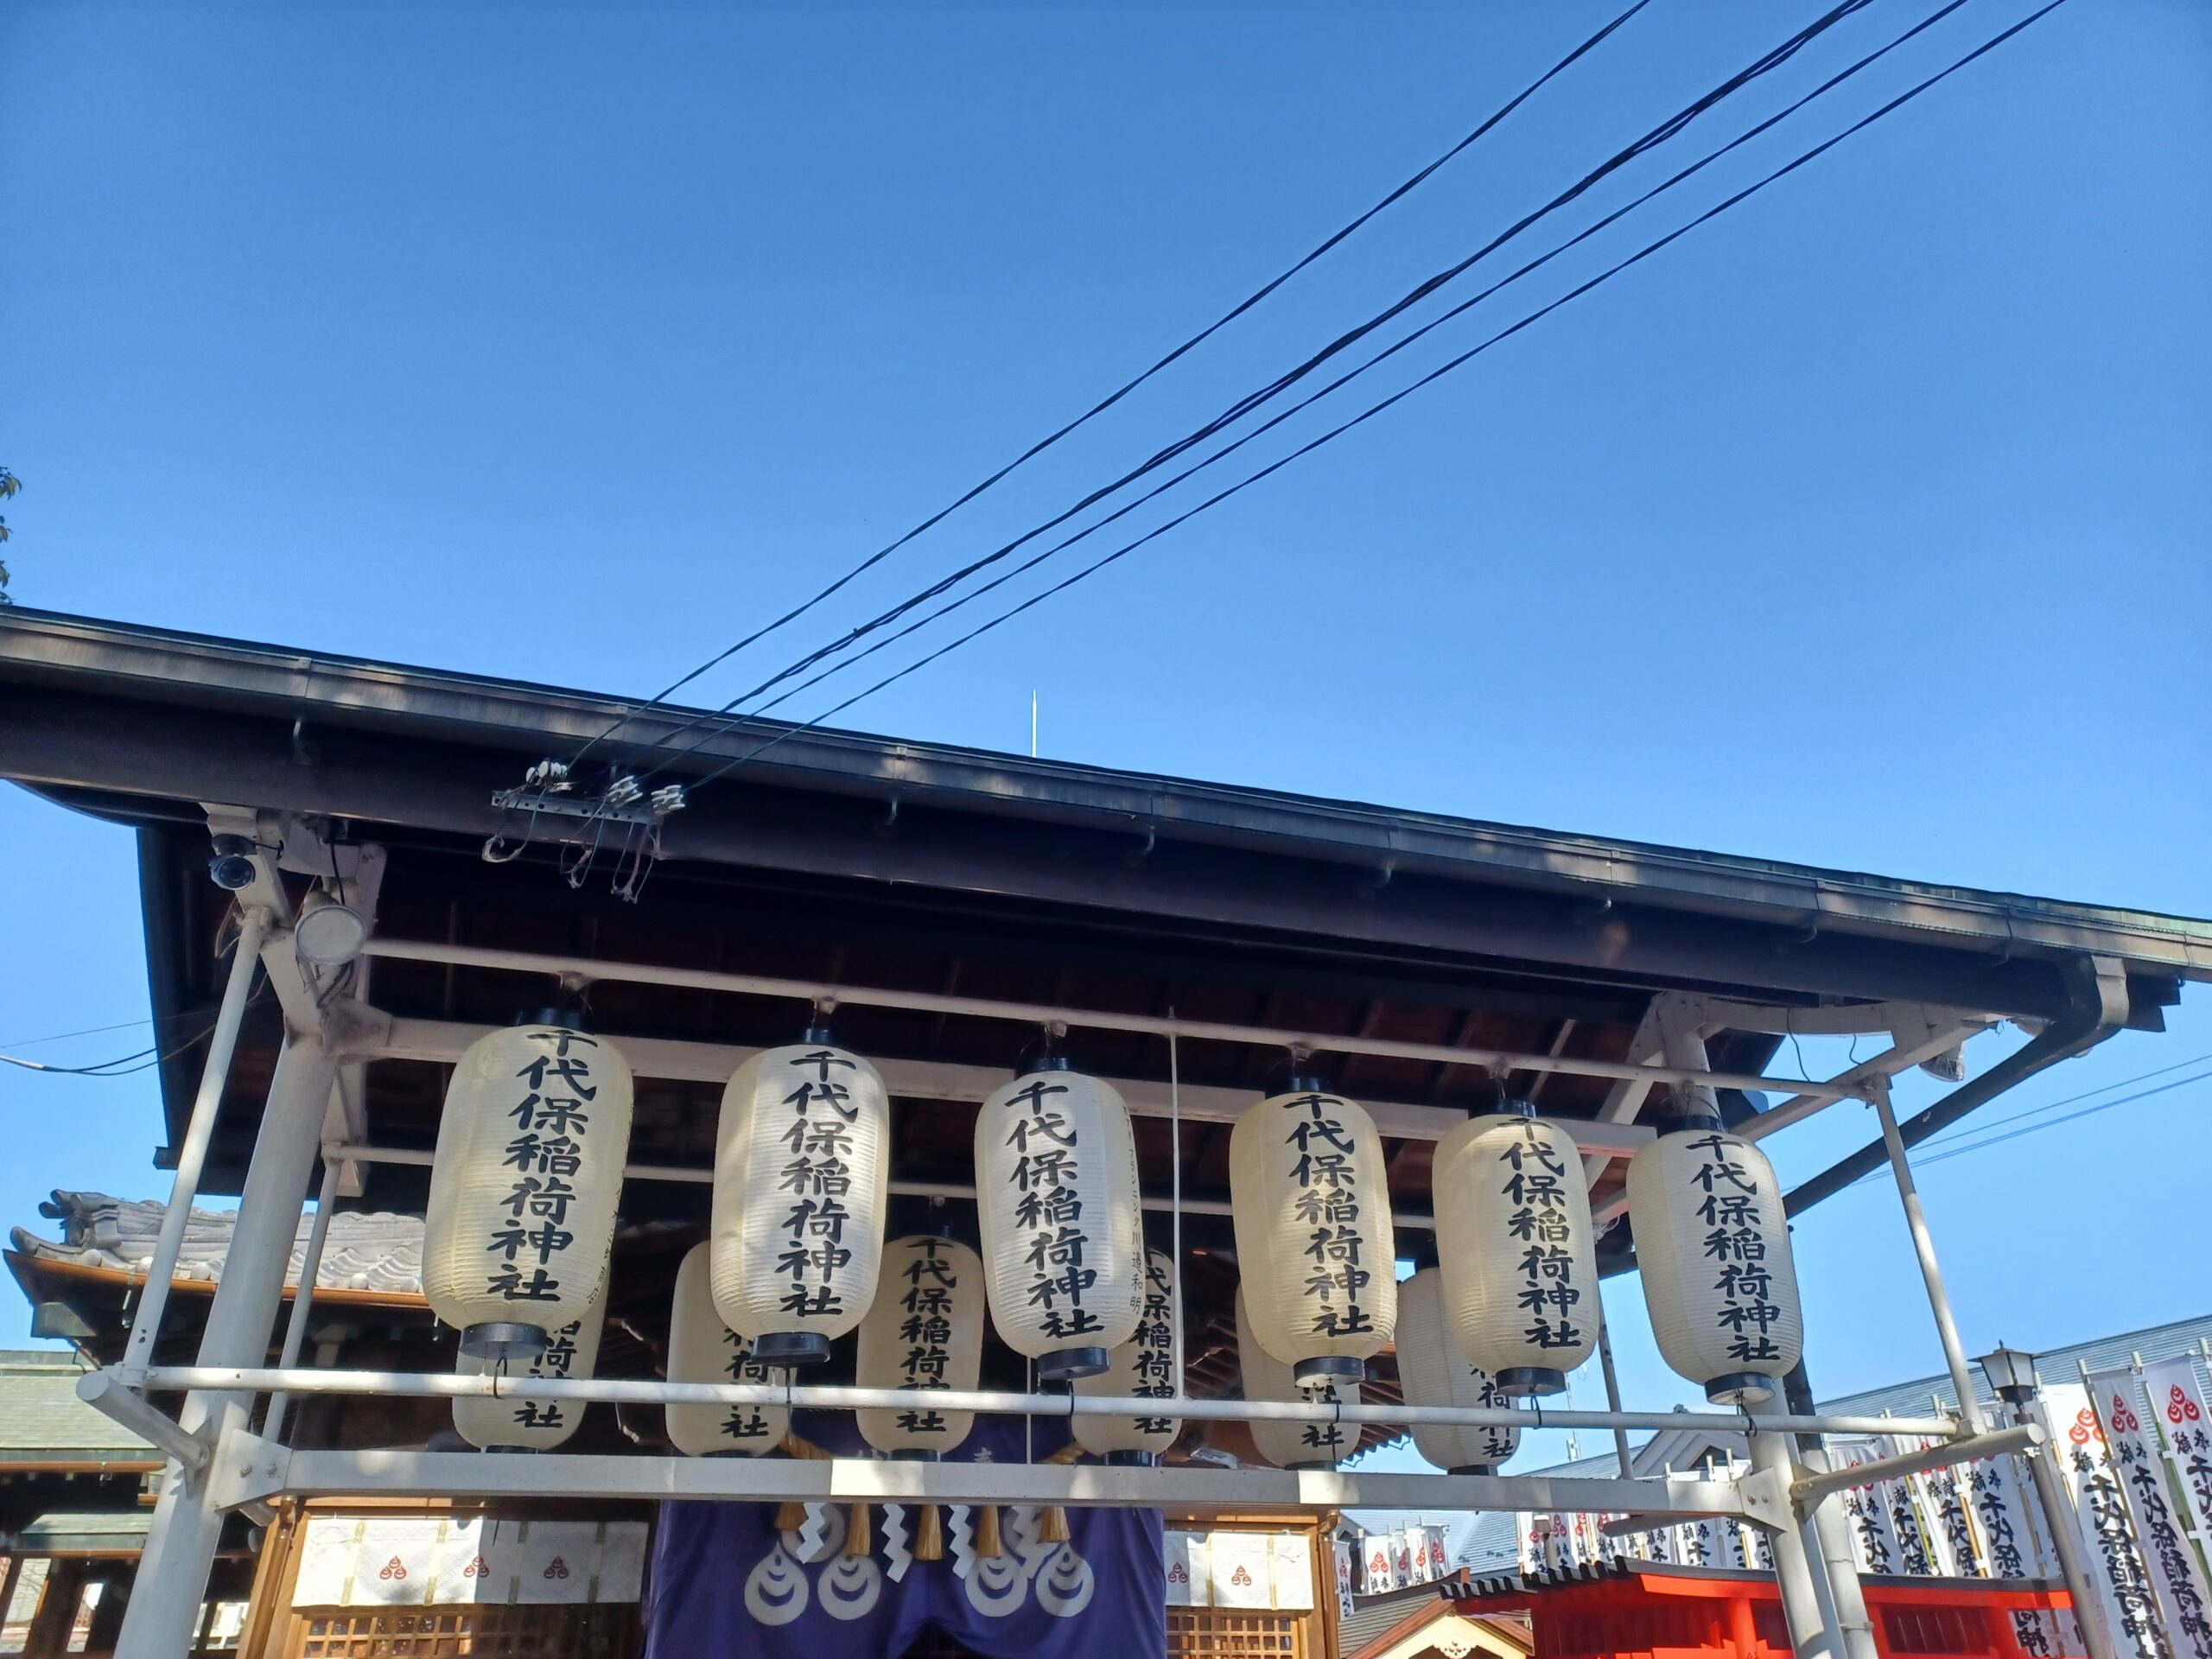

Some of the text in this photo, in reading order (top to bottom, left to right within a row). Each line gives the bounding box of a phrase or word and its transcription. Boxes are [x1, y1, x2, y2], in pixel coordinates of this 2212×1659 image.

[486, 1029, 598, 1302] 千代保稲荷神社
[775, 1051, 859, 1318] 千代保稲荷神社
[1005, 1081, 1104, 1339] 千代保稲荷神社
[1284, 1094, 1373, 1338] 千代保稲荷神社
[1497, 1117, 1582, 1350] 千代保稲荷神社
[1685, 1135, 1782, 1363] 千代保稲荷神社
